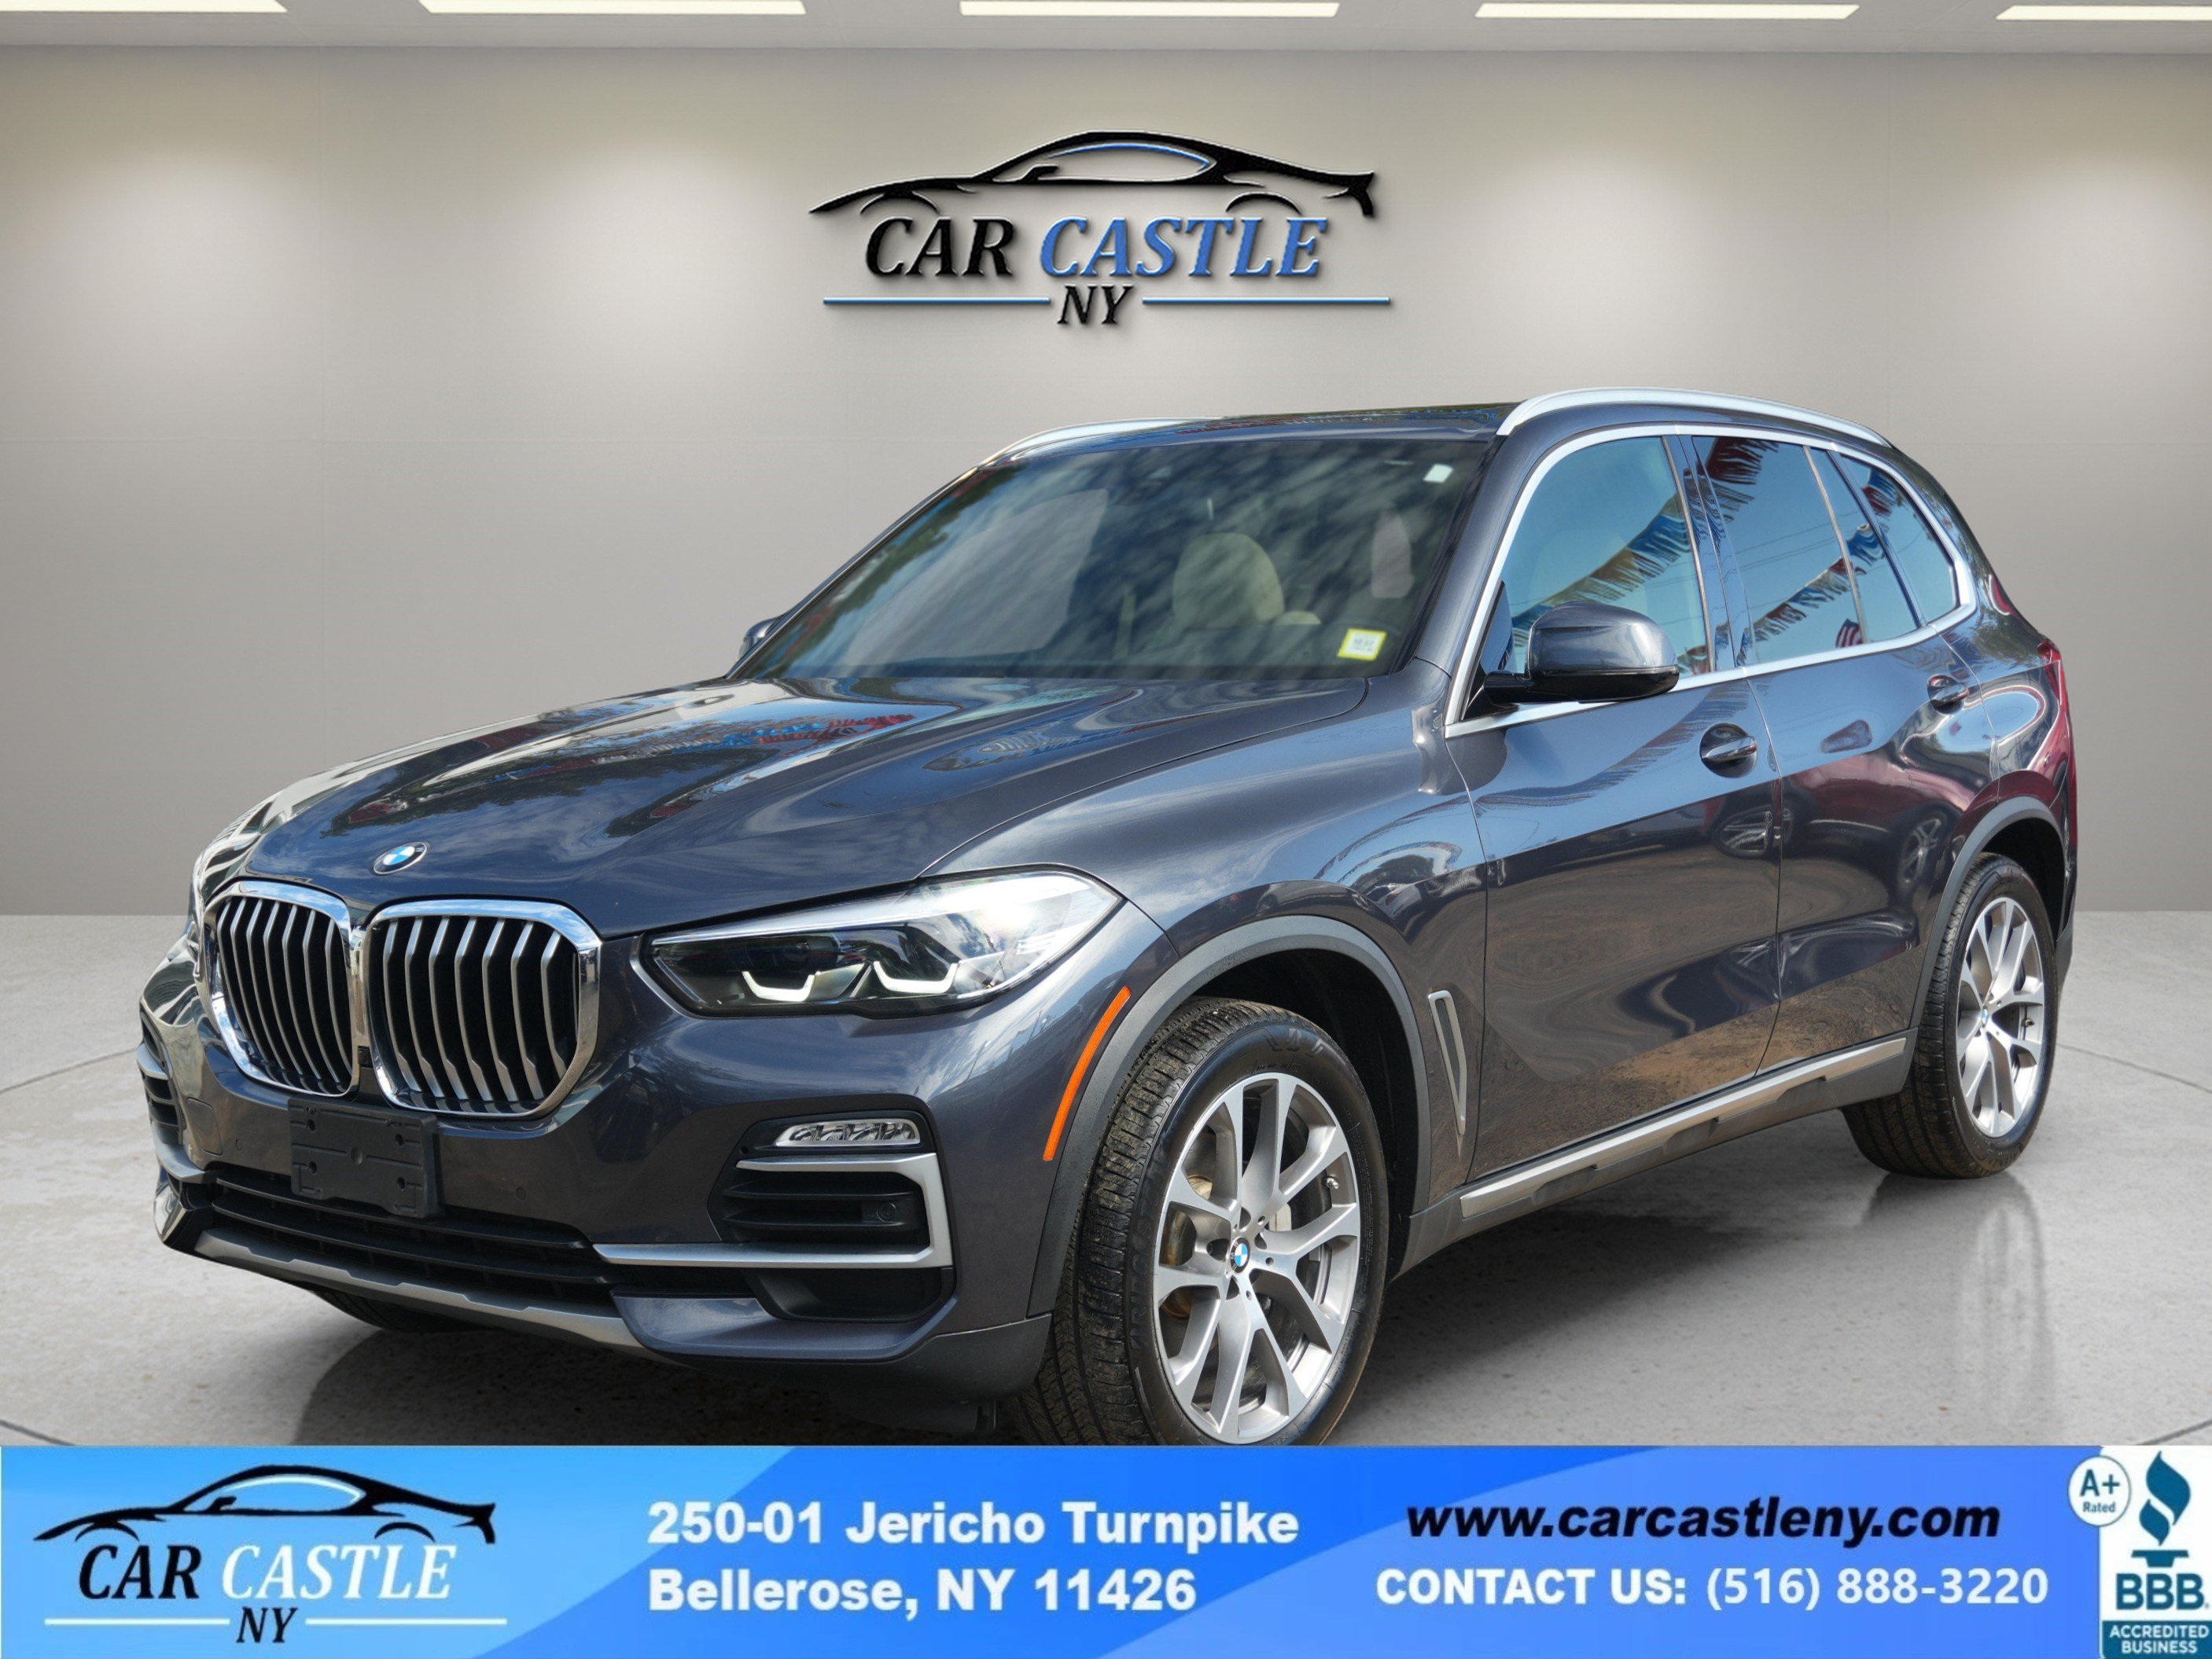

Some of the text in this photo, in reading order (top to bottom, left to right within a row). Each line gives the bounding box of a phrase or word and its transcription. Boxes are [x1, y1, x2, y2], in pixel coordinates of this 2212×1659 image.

[865, 217, 1327, 277] CAR CASTLE
[1058, 285, 1134, 325] NY
